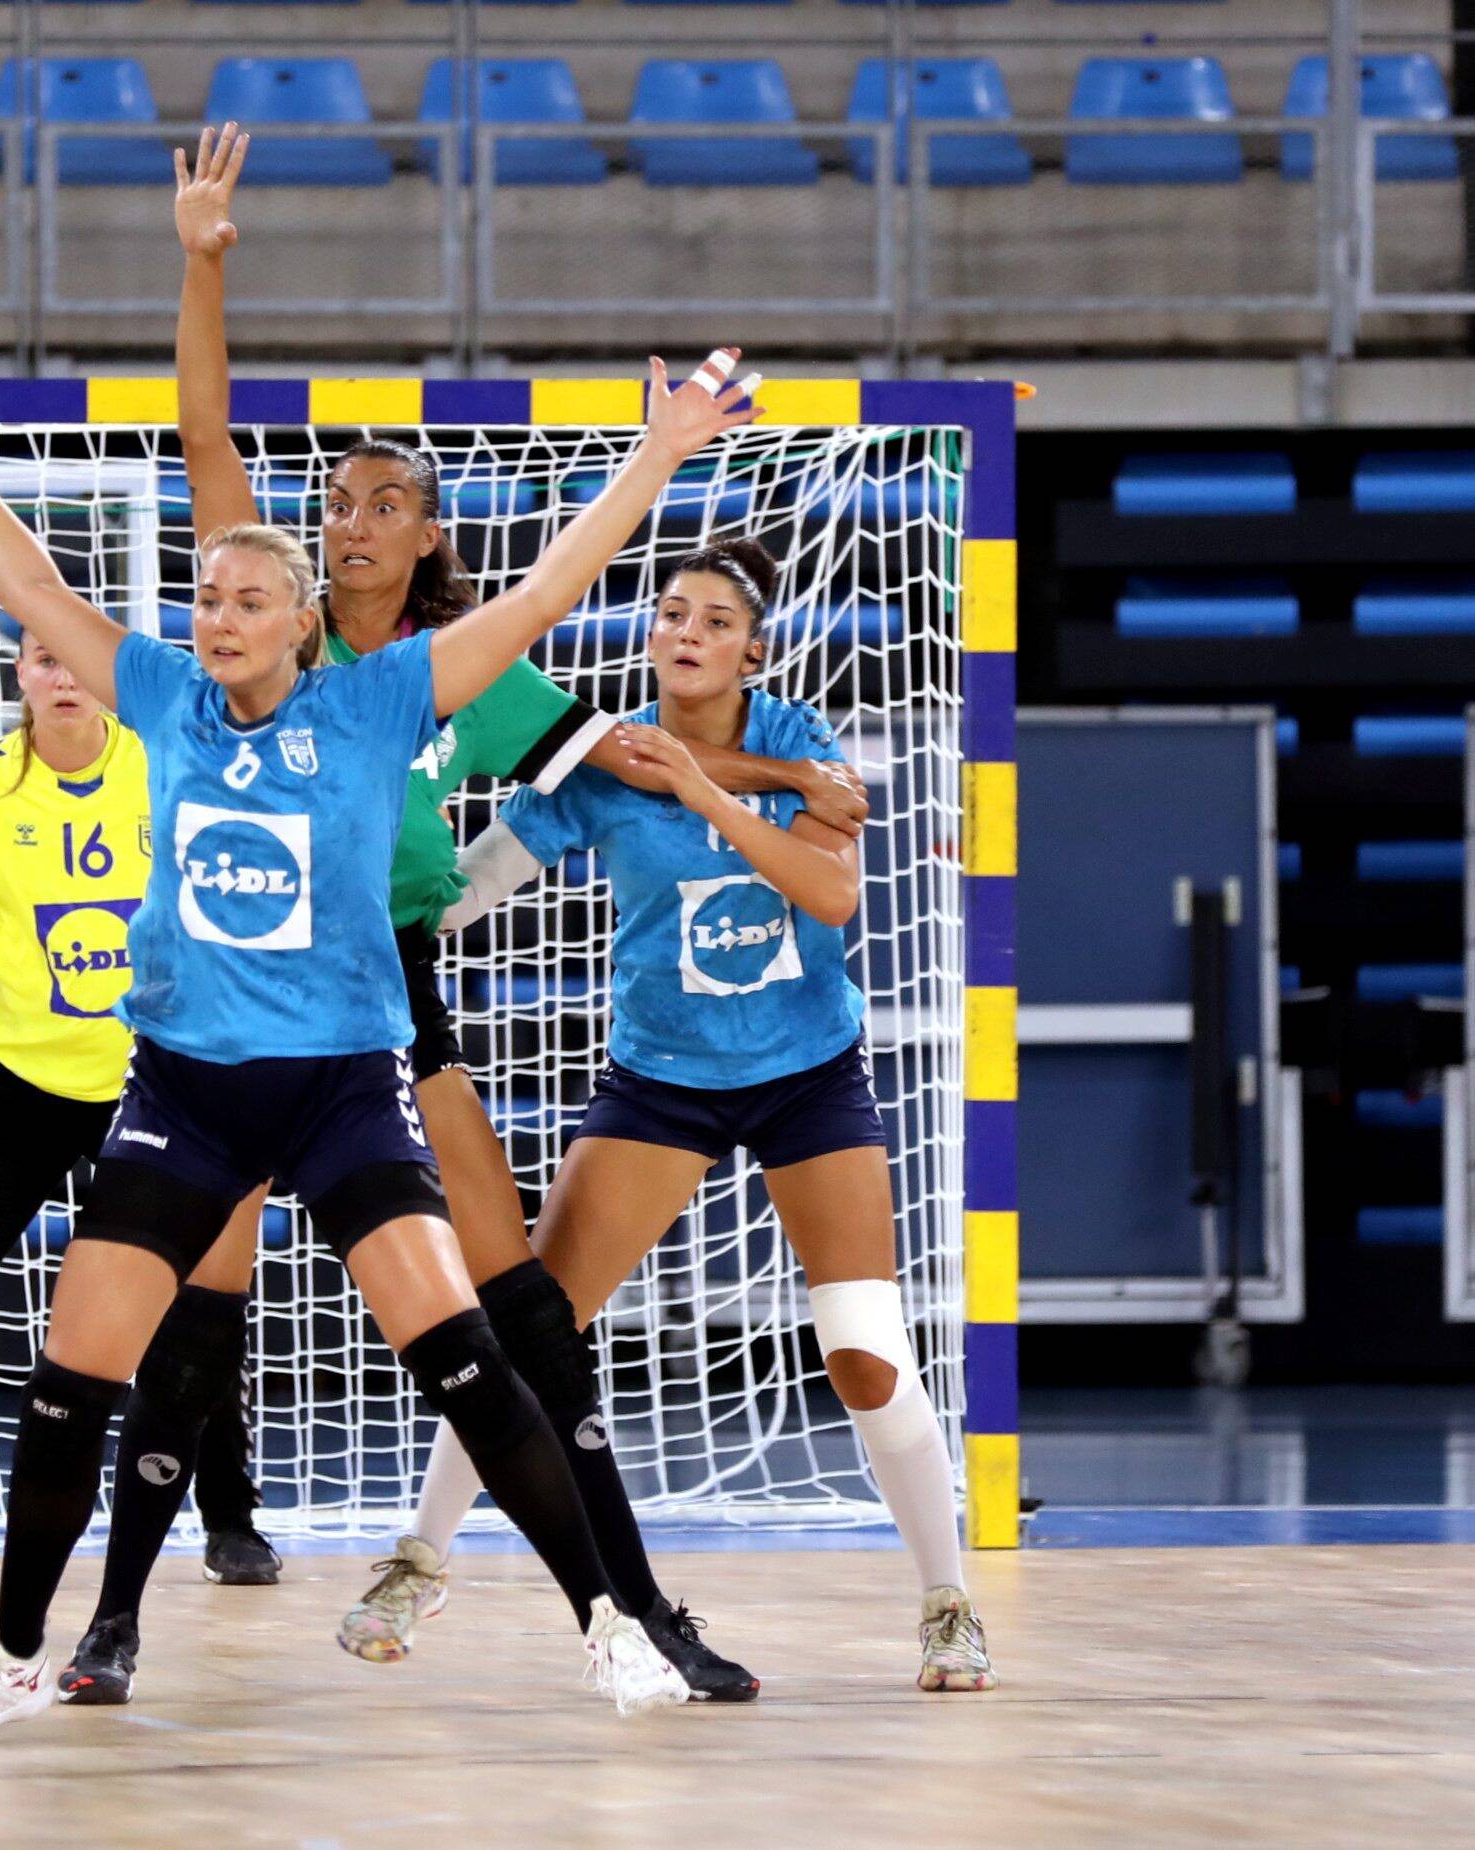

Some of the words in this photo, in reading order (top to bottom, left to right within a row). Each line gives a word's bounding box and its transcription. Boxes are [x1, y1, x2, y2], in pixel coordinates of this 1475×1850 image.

[223, 741, 262, 790] 6
[62, 822, 114, 879] 16
[119, 1127, 170, 1151] hummel
[440, 1361, 481, 1391] SELECT
[32, 1398, 70, 1420] SELECT
